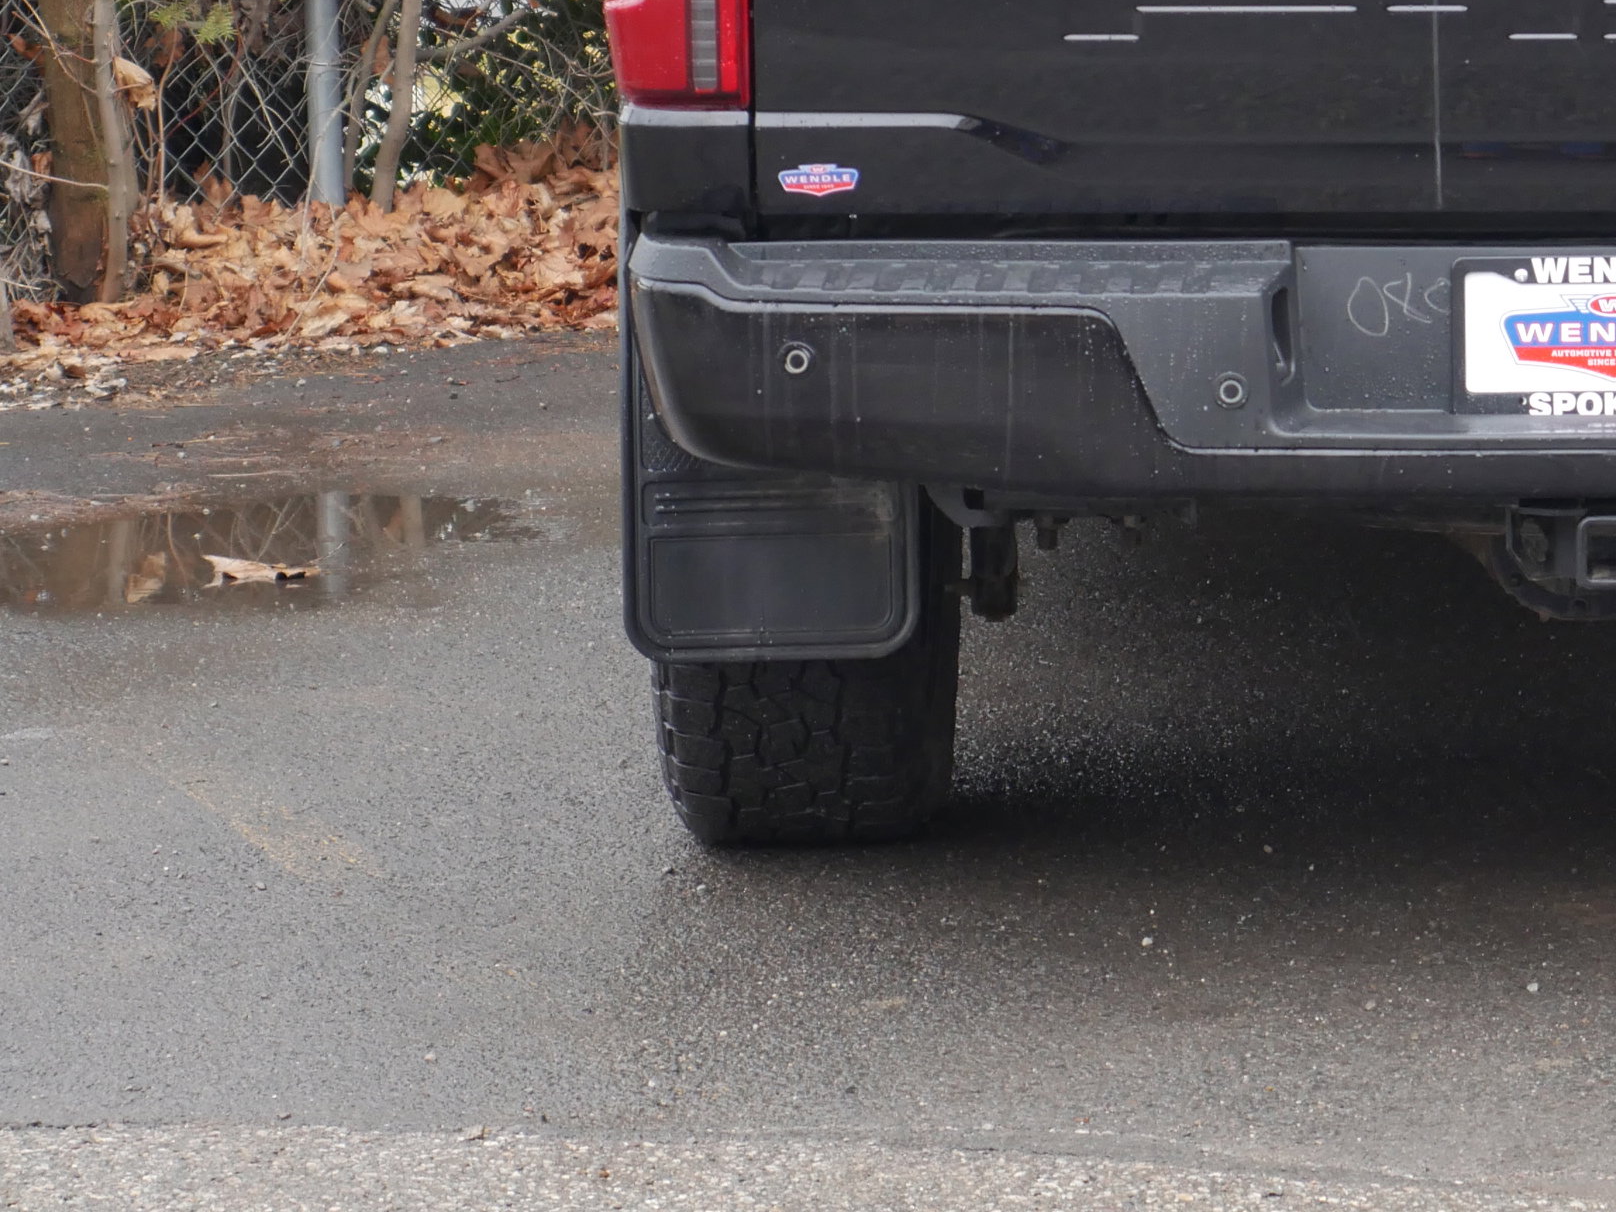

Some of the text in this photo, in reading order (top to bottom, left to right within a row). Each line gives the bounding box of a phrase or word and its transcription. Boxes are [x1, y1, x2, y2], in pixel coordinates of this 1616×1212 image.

[784, 174, 851, 184] WENDLE
[1551, 349, 1612, 357] AUTOMOTIVE
[1587, 358, 1616, 366] SINCE
